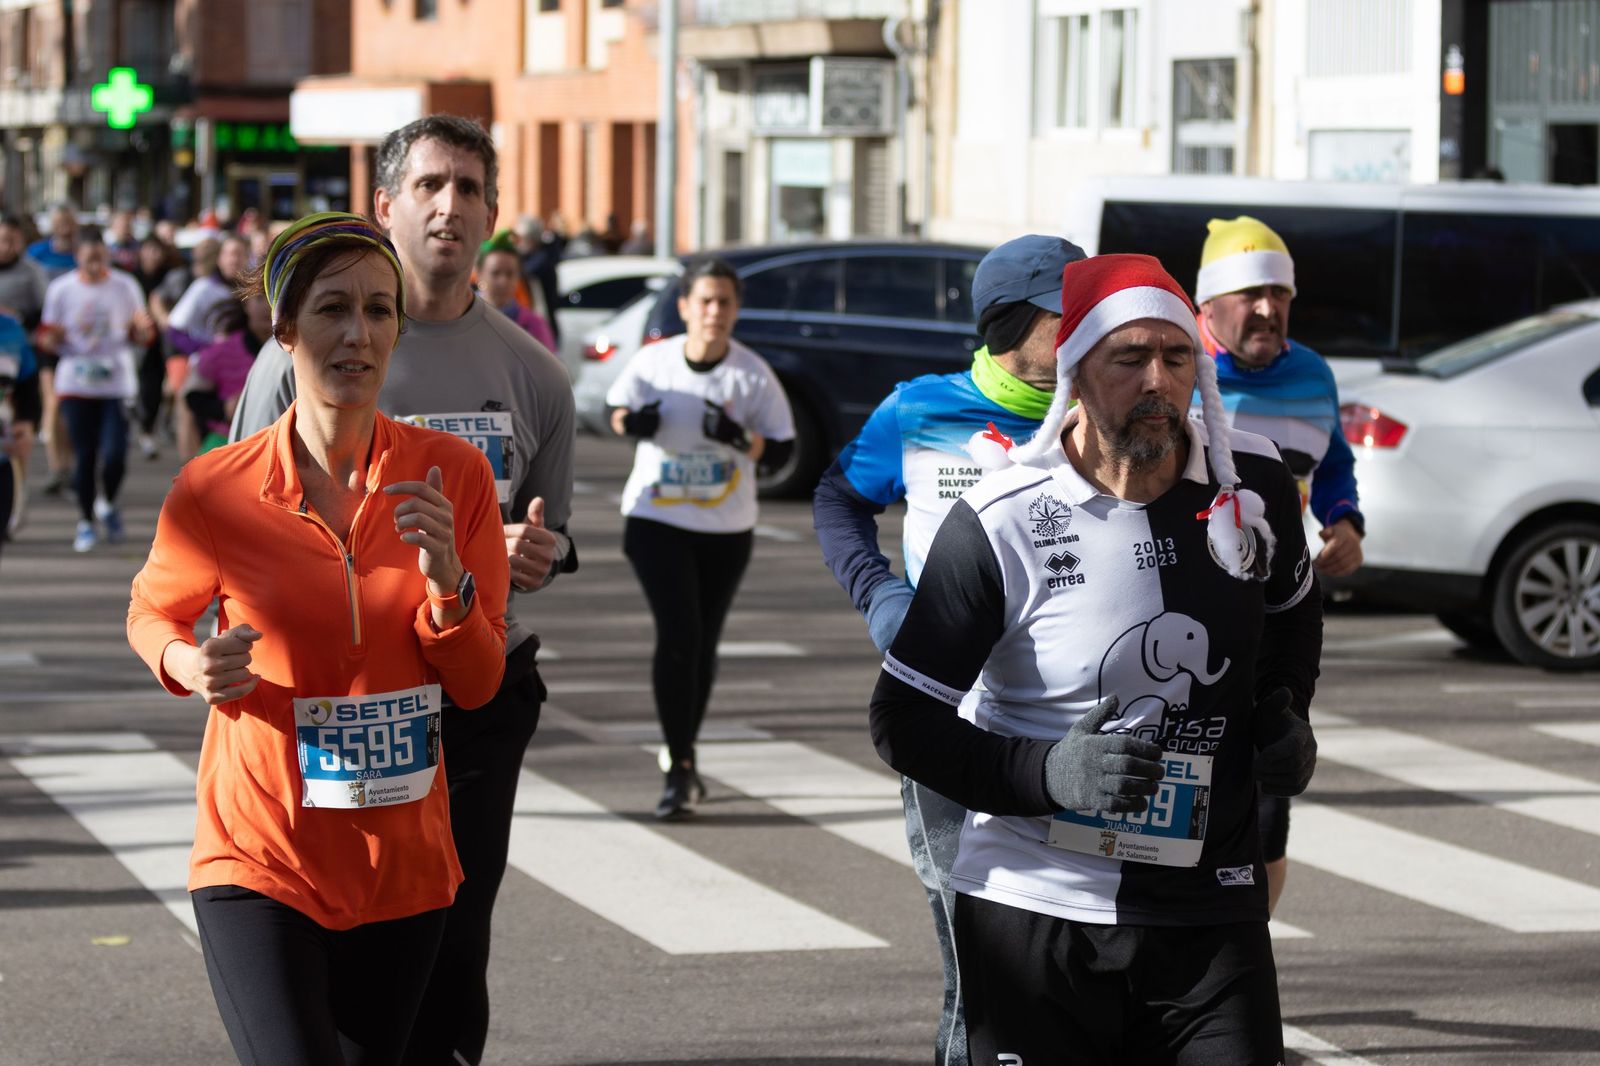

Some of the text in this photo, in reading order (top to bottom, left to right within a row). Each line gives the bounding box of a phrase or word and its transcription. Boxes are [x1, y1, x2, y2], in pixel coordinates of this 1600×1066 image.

[428, 418, 502, 431] SETEL
[938, 467, 982, 476] XLI SAN
[1133, 537, 1175, 556] 2013
[1136, 552, 1178, 571] 2023
[1047, 572, 1086, 589] errea
[336, 695, 428, 721] SETEL
[318, 720, 414, 772] 5595
[356, 769, 382, 780] SARA
[368, 784, 409, 796] Ayuntamiento
[378, 793, 410, 804] Salamanca
[1104, 820, 1142, 834] JUANJO
[1118, 842, 1160, 854] Ayuntamiento
[1126, 852, 1158, 862] Salamanca
